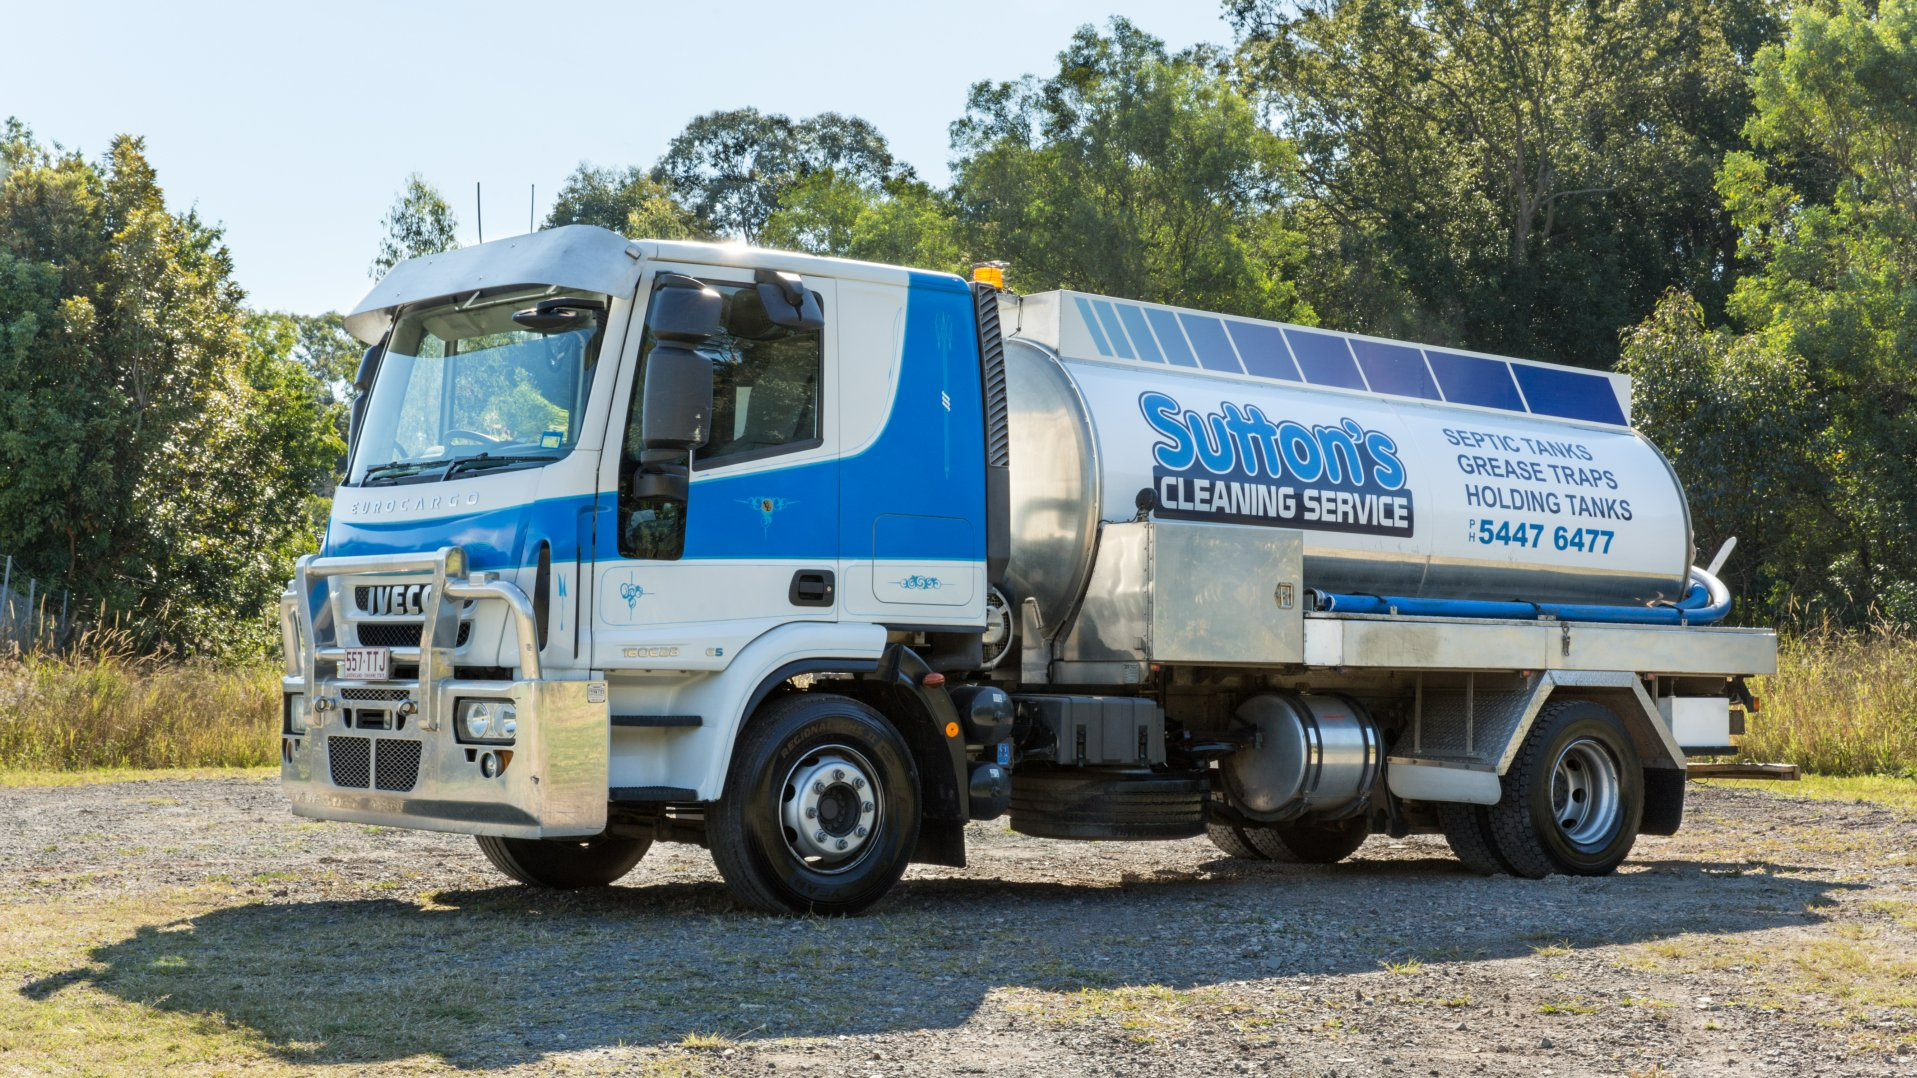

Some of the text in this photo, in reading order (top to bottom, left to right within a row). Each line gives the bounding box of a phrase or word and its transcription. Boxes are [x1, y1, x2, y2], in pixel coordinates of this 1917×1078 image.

[1139, 391, 1406, 491] Sutton's
[1443, 428, 1593, 461] SEPTIC TANKS
[1457, 454, 1618, 490] GREASE TRAPS
[351, 491, 480, 515] EUROCARGO
[1160, 476, 1409, 528] CLEANING SERVICE
[1465, 484, 1633, 521] HOLDING TANKS
[1478, 519, 1545, 548] 5447
[1554, 526, 1615, 554] 6477
[781, 720, 832, 758] REGIONAL
